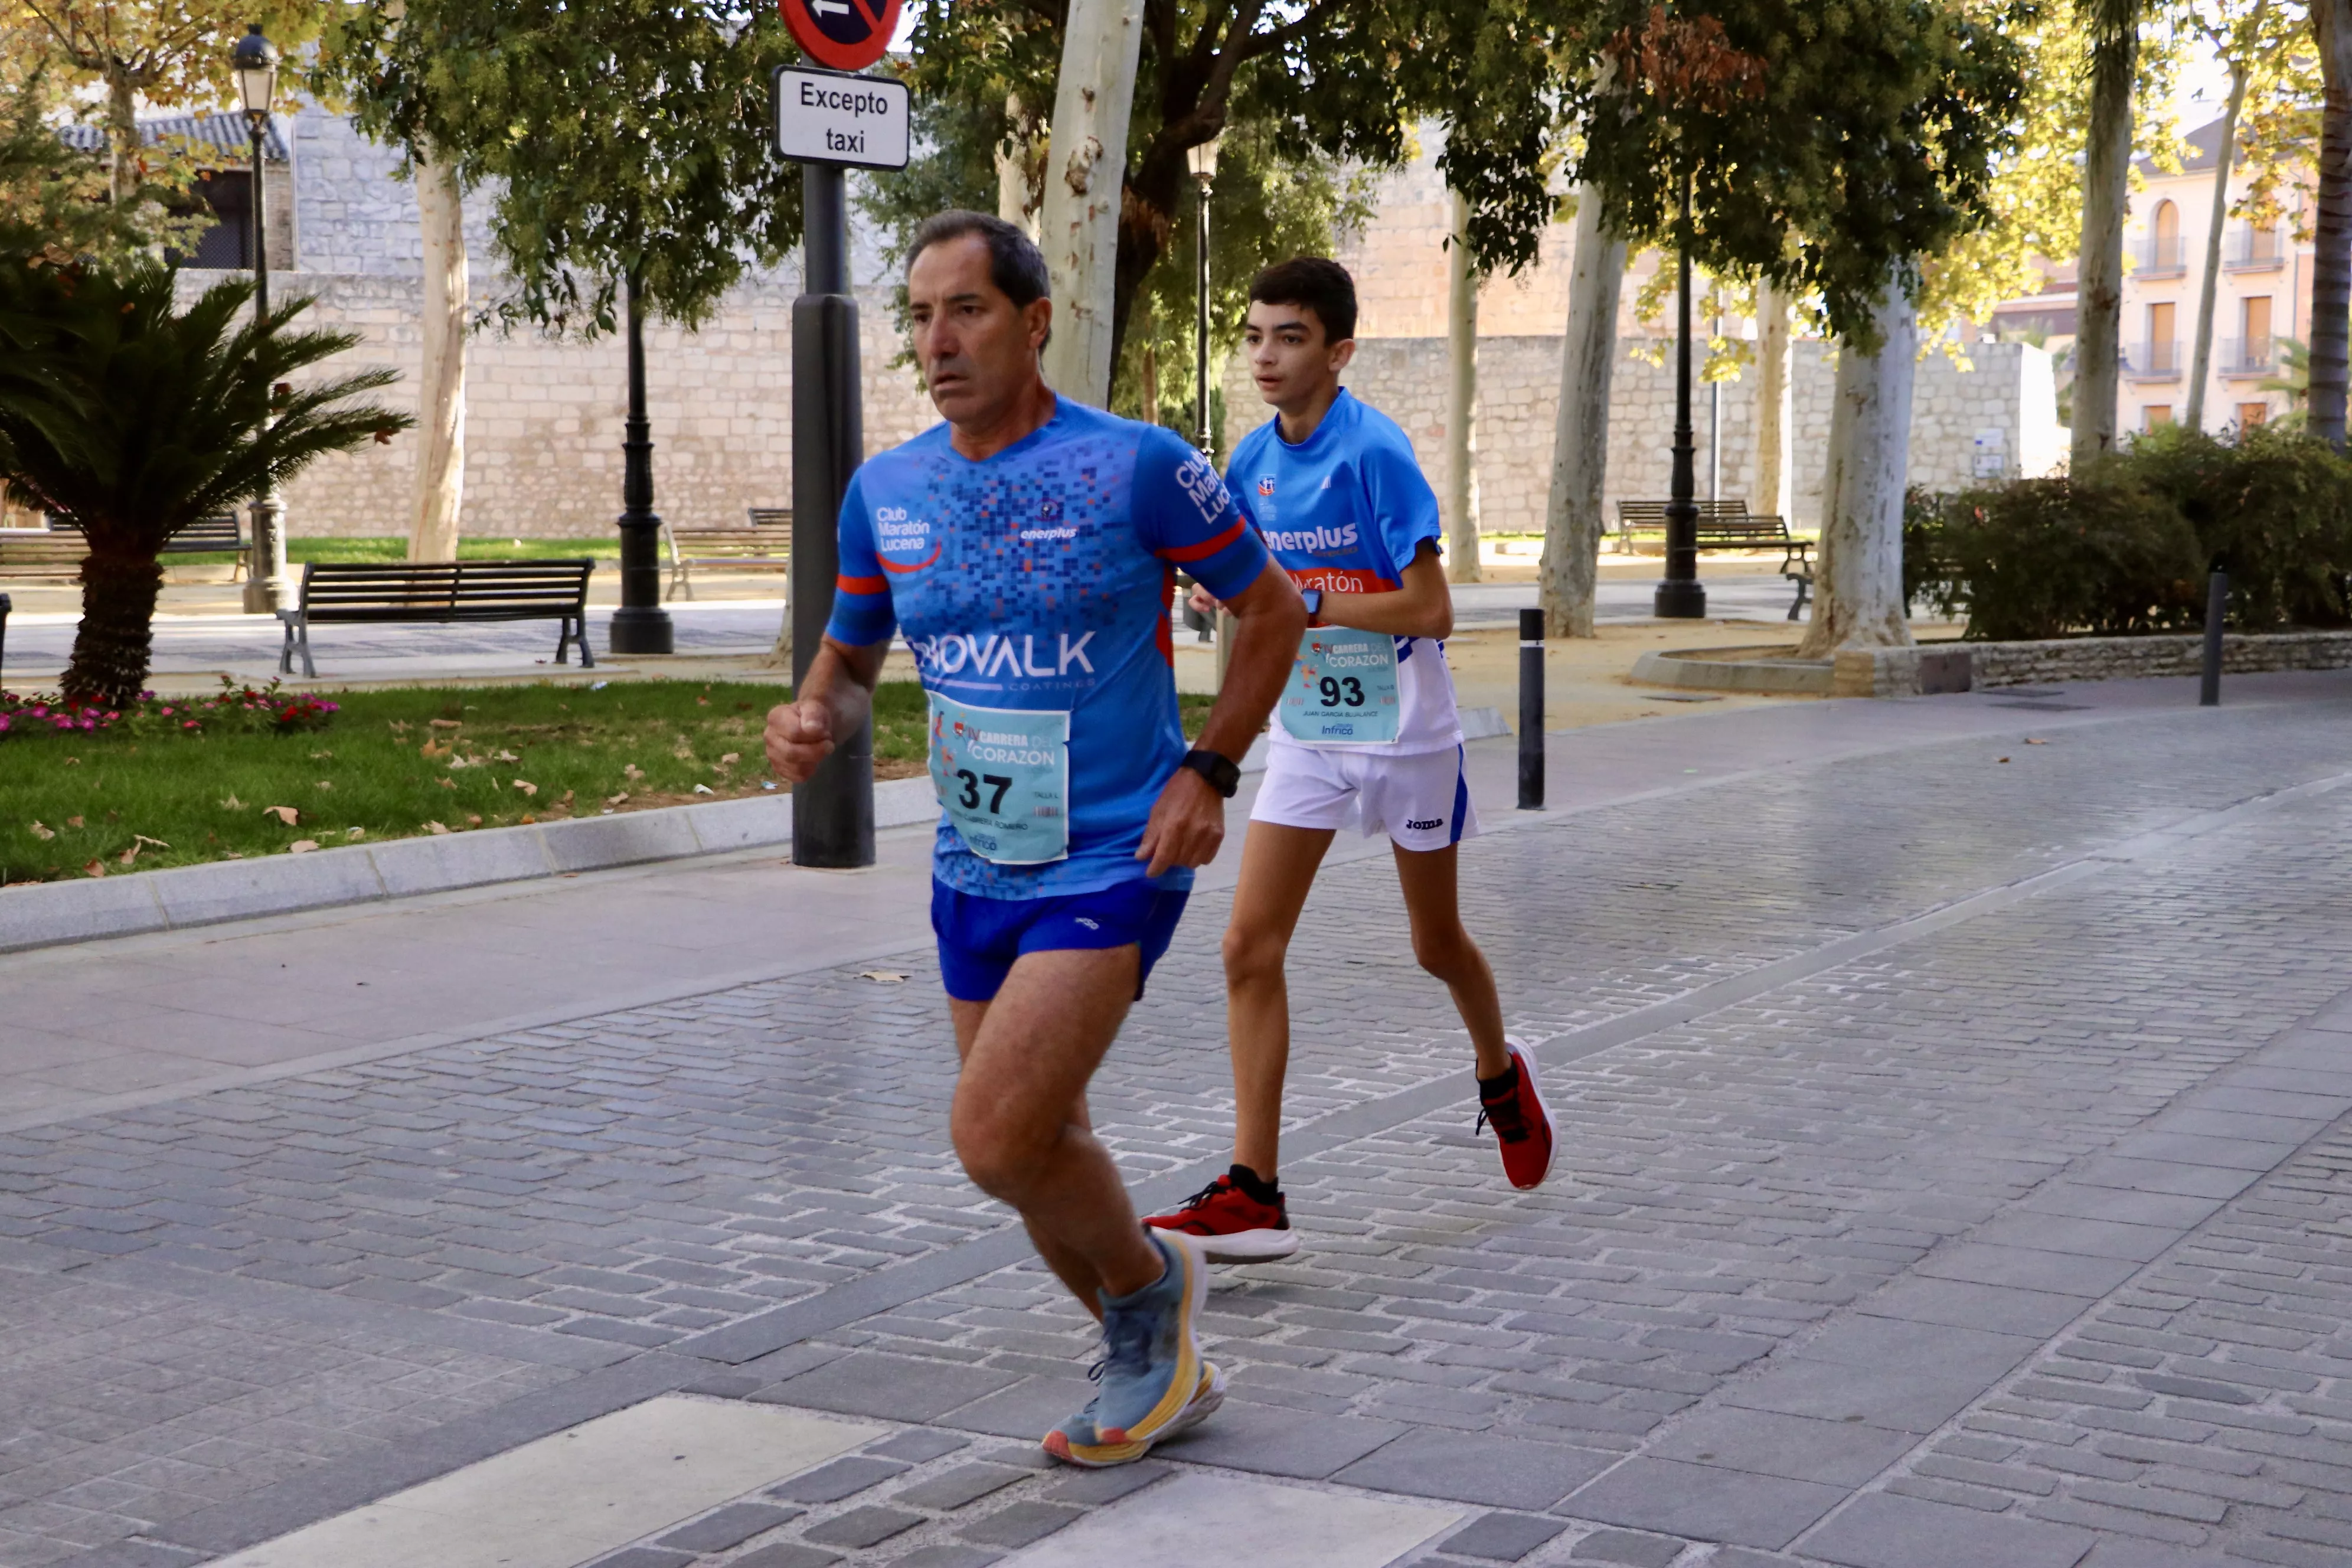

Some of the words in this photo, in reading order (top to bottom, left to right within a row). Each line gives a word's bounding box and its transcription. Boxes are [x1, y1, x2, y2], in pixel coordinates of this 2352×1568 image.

[801, 81, 888, 117] Excepto
[827, 128, 864, 153] taxi
[1175, 450, 1207, 489] Club
[877, 507, 907, 521] Club
[878, 520, 930, 536] Maratón
[1021, 527, 1077, 541] enerplus
[1262, 522, 1358, 554] enerplus
[880, 538, 925, 552] Lucena
[1320, 676, 1365, 707] 93
[979, 731, 1029, 747] CARRERA
[957, 769, 1013, 815] 37
